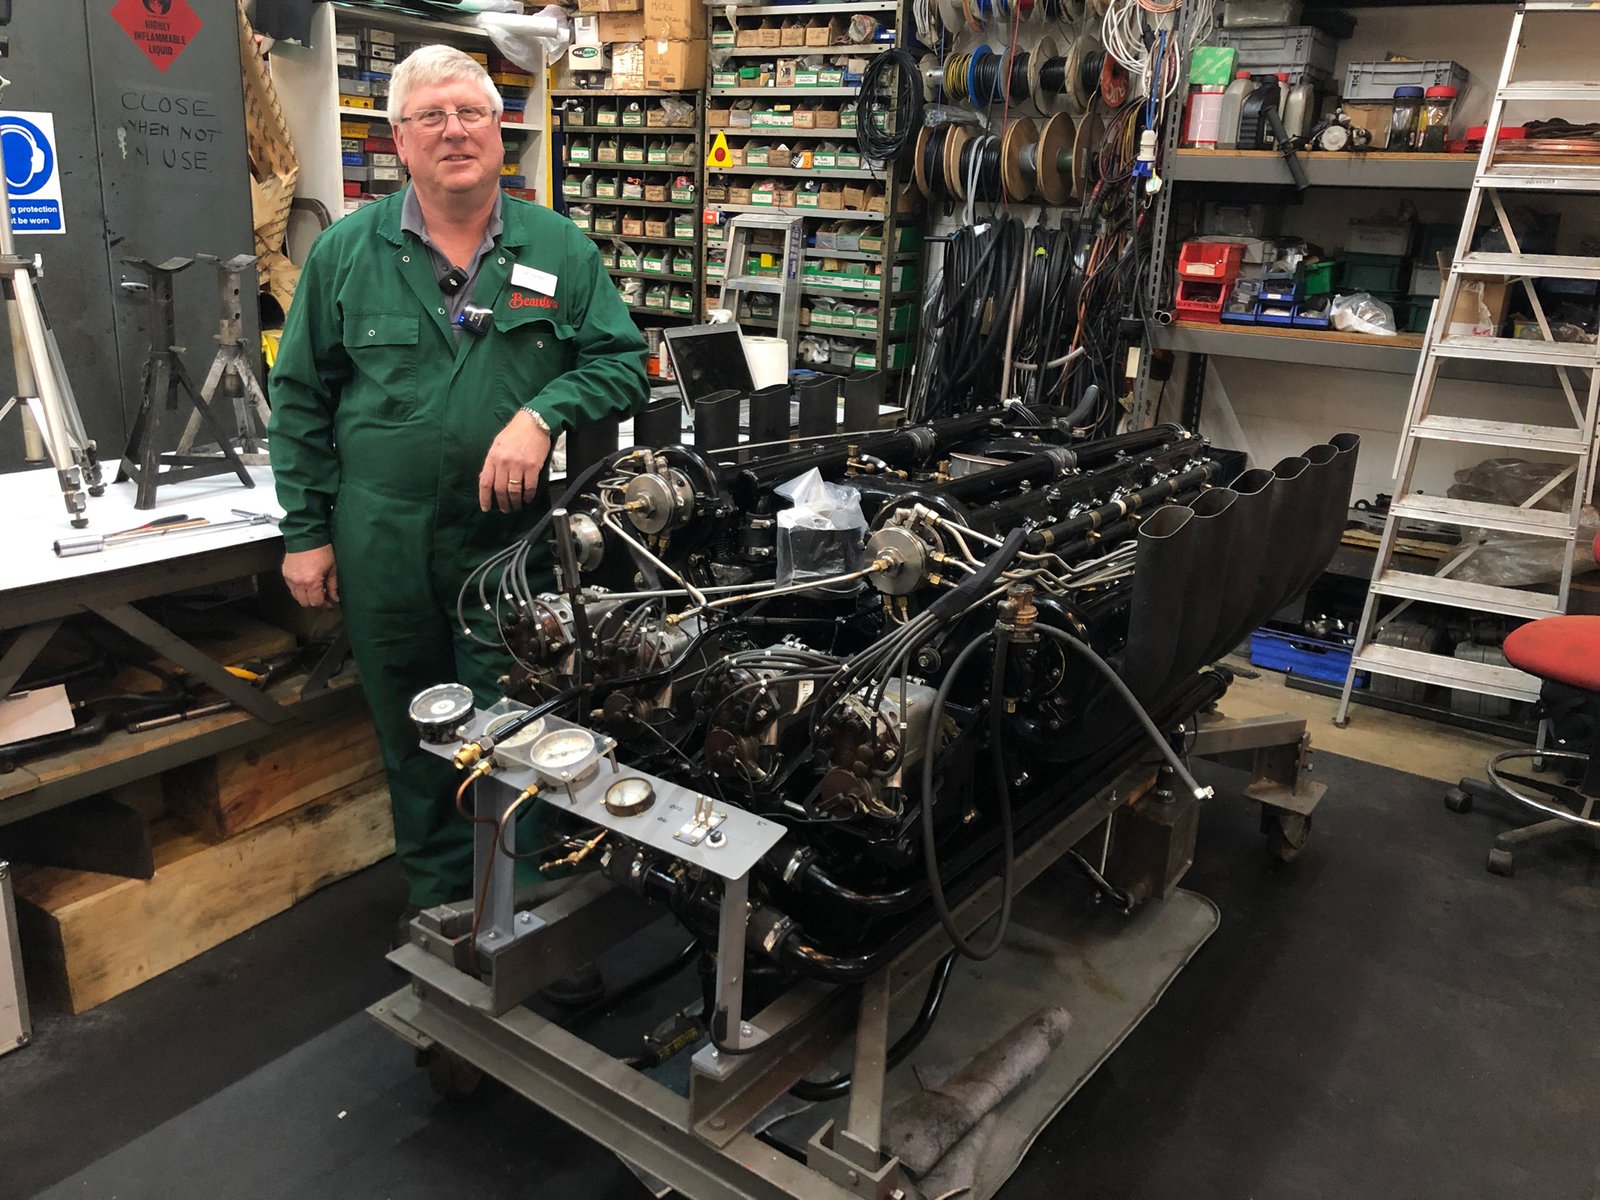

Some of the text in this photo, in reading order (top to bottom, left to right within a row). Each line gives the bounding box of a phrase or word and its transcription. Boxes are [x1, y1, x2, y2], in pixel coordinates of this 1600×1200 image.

[145, 20, 171, 31] HIGHLY
[134, 31, 187, 45] INFLAMMABLE
[148, 44, 174, 56] LIQUID
[121, 91, 216, 117] CLOSE
[180, 126, 223, 143] NOT
[18, 206, 58, 214] protection
[18, 217, 28, 225] be
